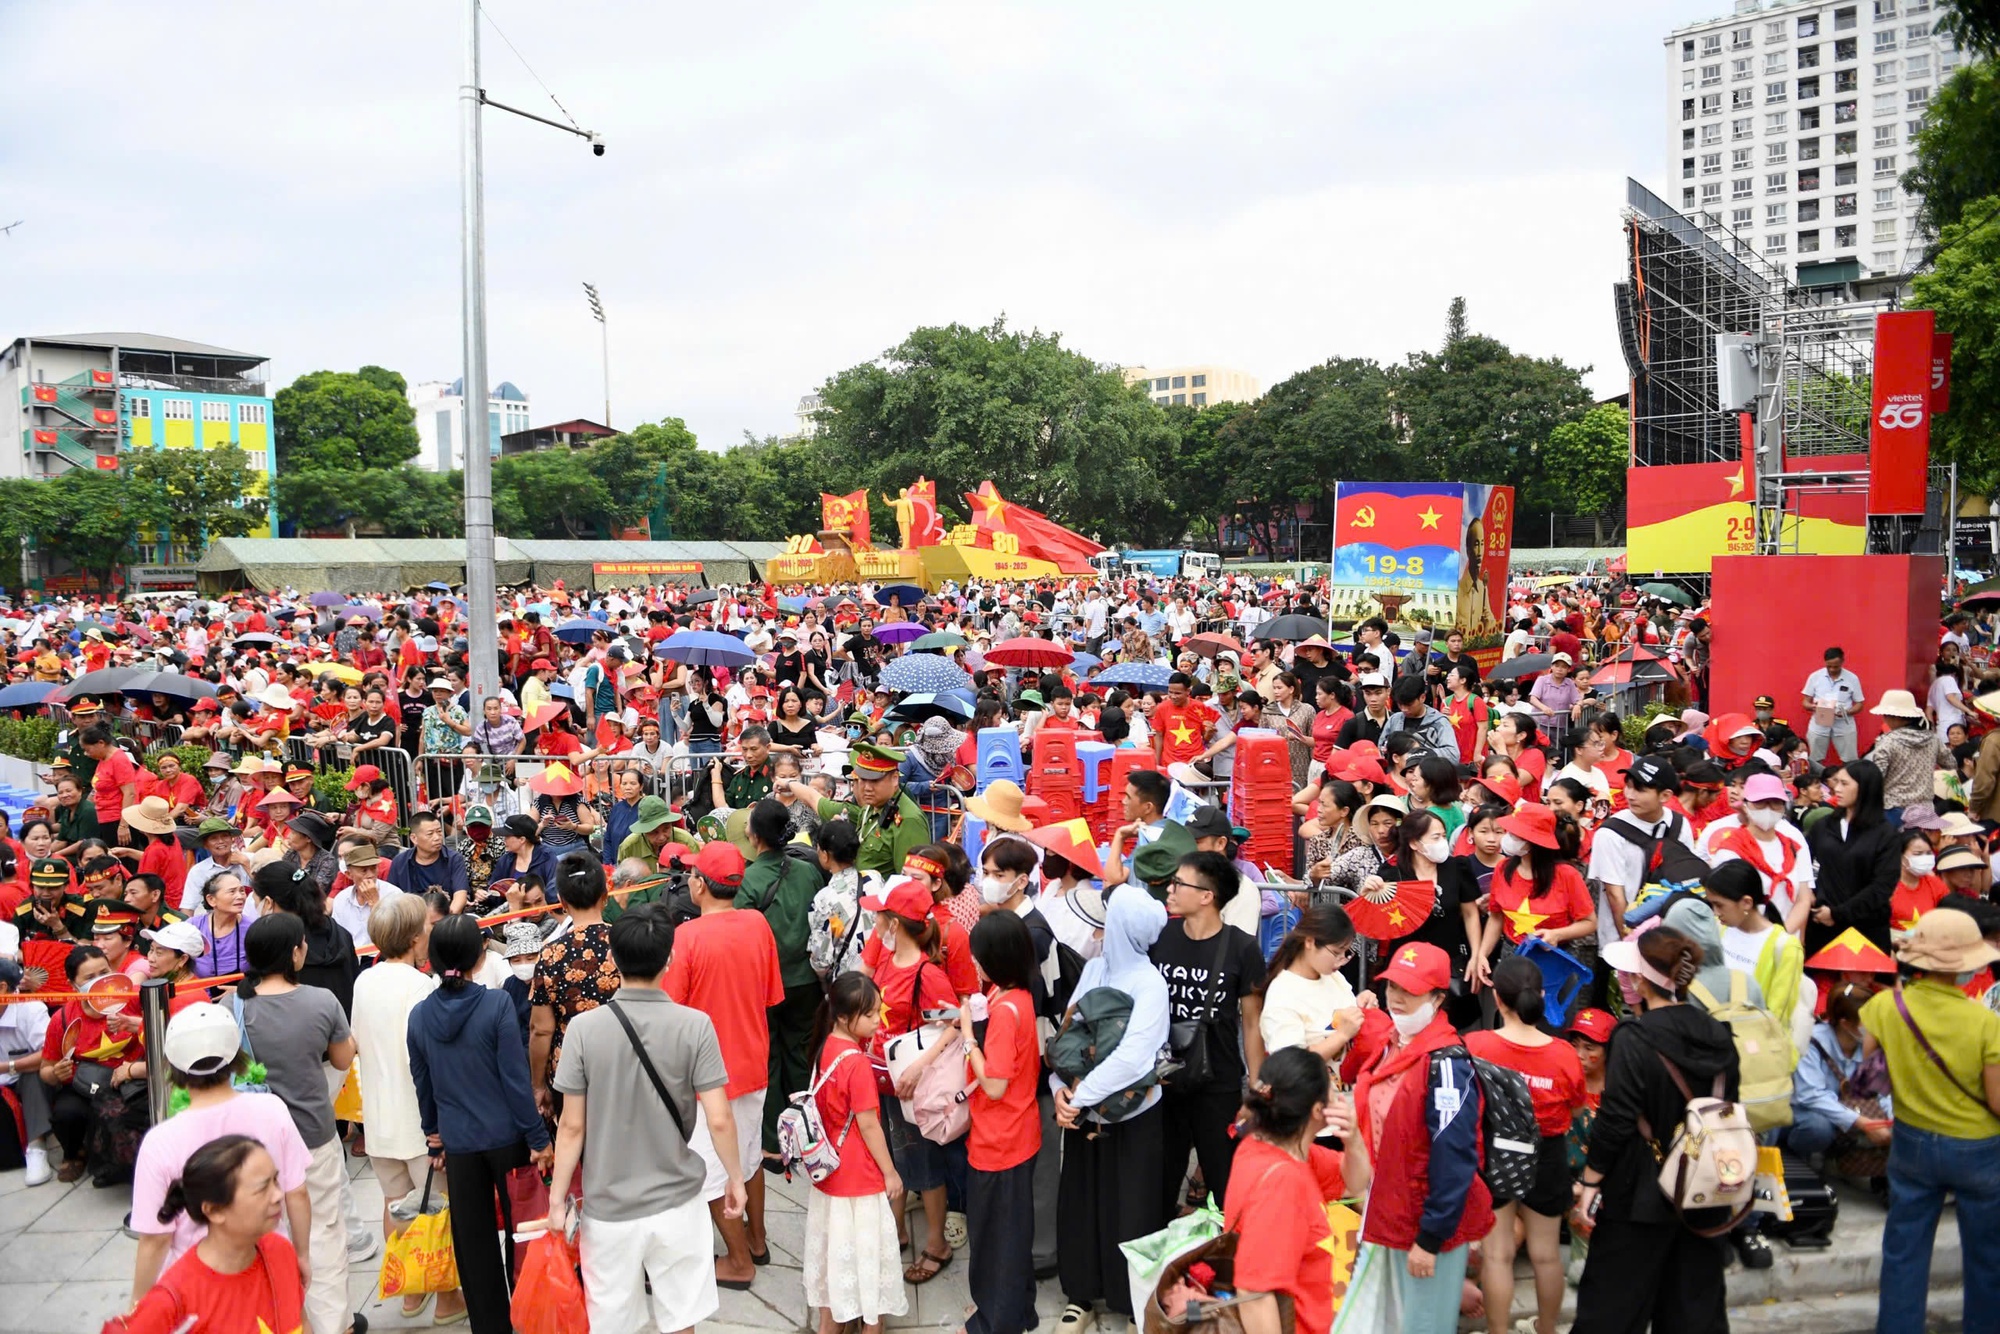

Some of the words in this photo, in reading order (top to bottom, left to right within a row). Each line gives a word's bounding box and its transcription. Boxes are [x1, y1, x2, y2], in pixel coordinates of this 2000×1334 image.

[1887, 394, 1923, 402] viettel
[1879, 403, 1923, 429] 5G
[1727, 517, 1756, 541] 2-9
[786, 533, 815, 555] 80
[992, 531, 1019, 555] 80
[995, 562, 1008, 570] 1945
[1013, 562, 1028, 570] 2025
[1365, 555, 1424, 575] 19-8
[1364, 576, 1424, 589] 1945-2025
[1531, 1075, 1553, 1091] NAM
